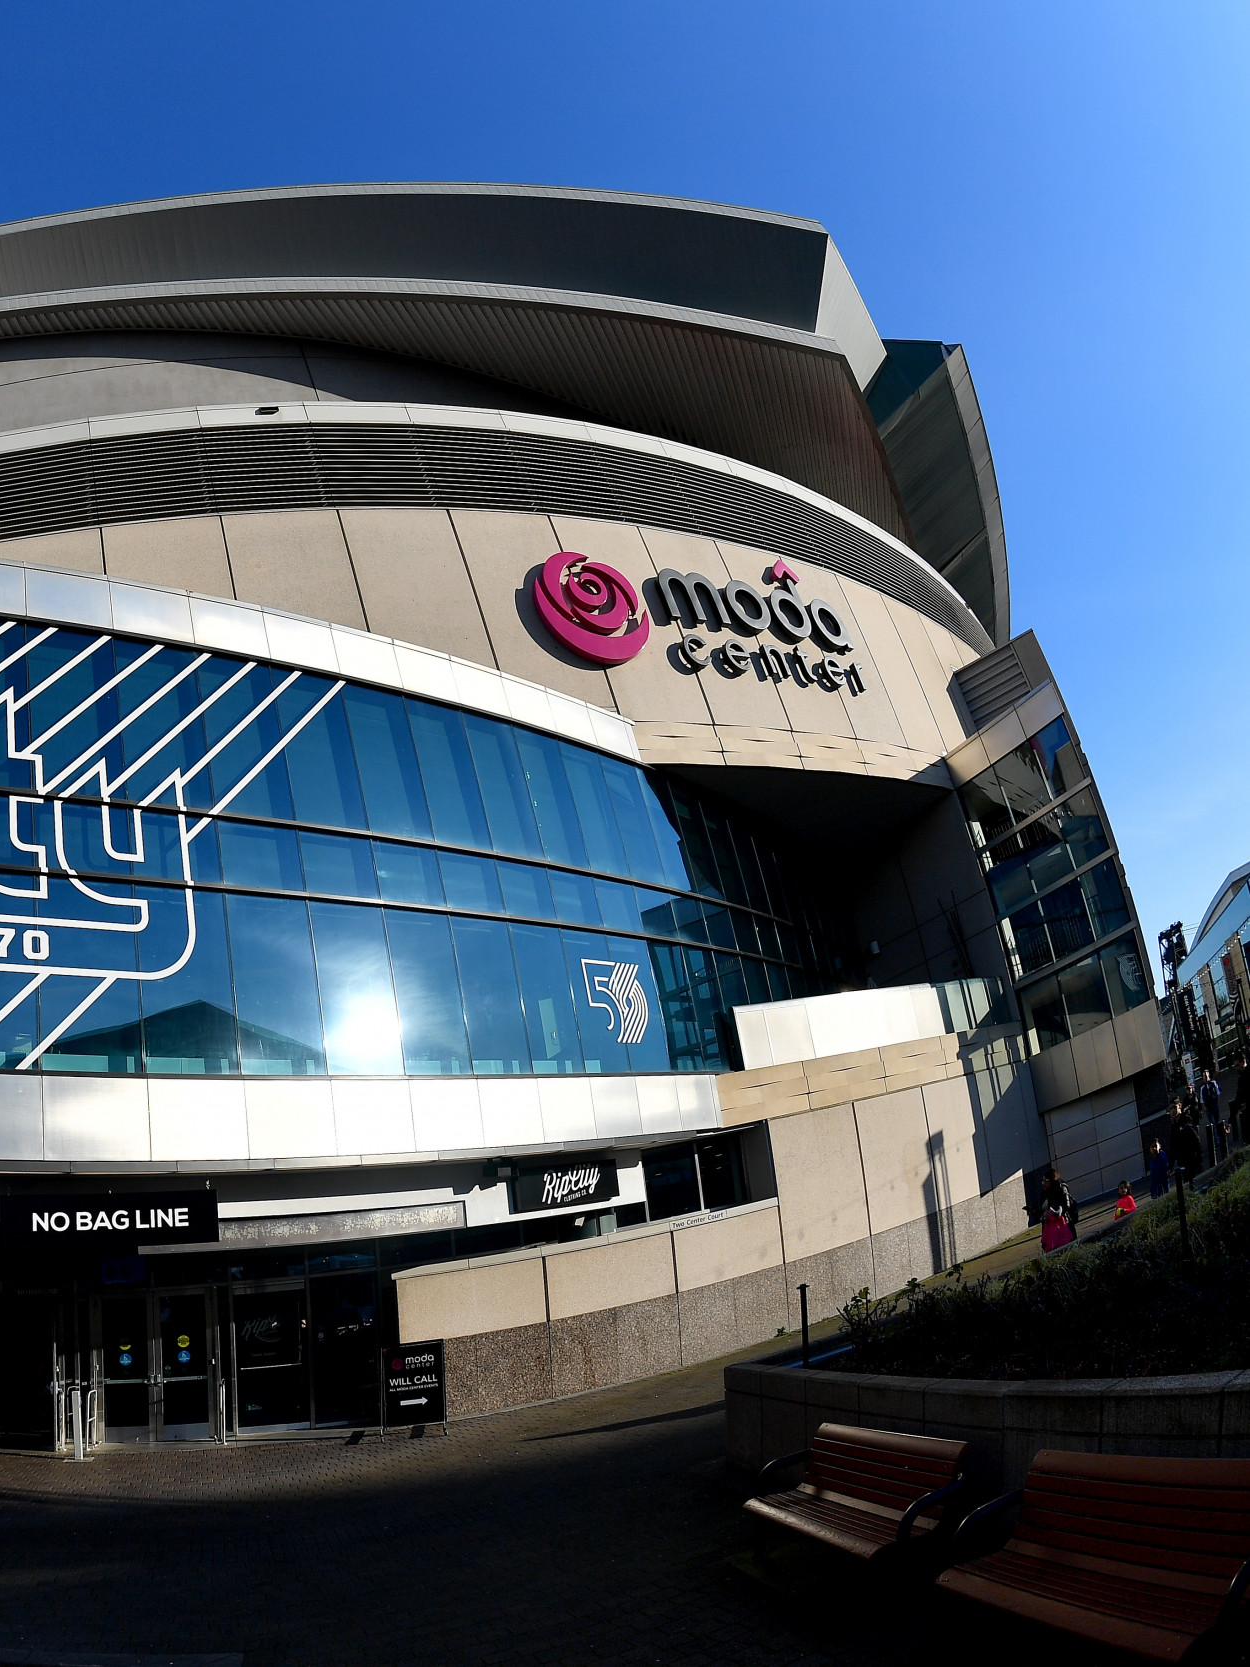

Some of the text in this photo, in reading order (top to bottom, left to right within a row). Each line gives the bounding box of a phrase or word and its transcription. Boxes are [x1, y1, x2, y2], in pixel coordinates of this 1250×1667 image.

[656, 560, 854, 655] moda
[681, 633, 867, 694] center
[32, 1207, 190, 1232] NO BAG LINE
[672, 1211, 724, 1229] Two Center Court
[405, 1353, 435, 1365] moda
[405, 1361, 435, 1370] center
[389, 1374, 438, 1387] WILL CALL
